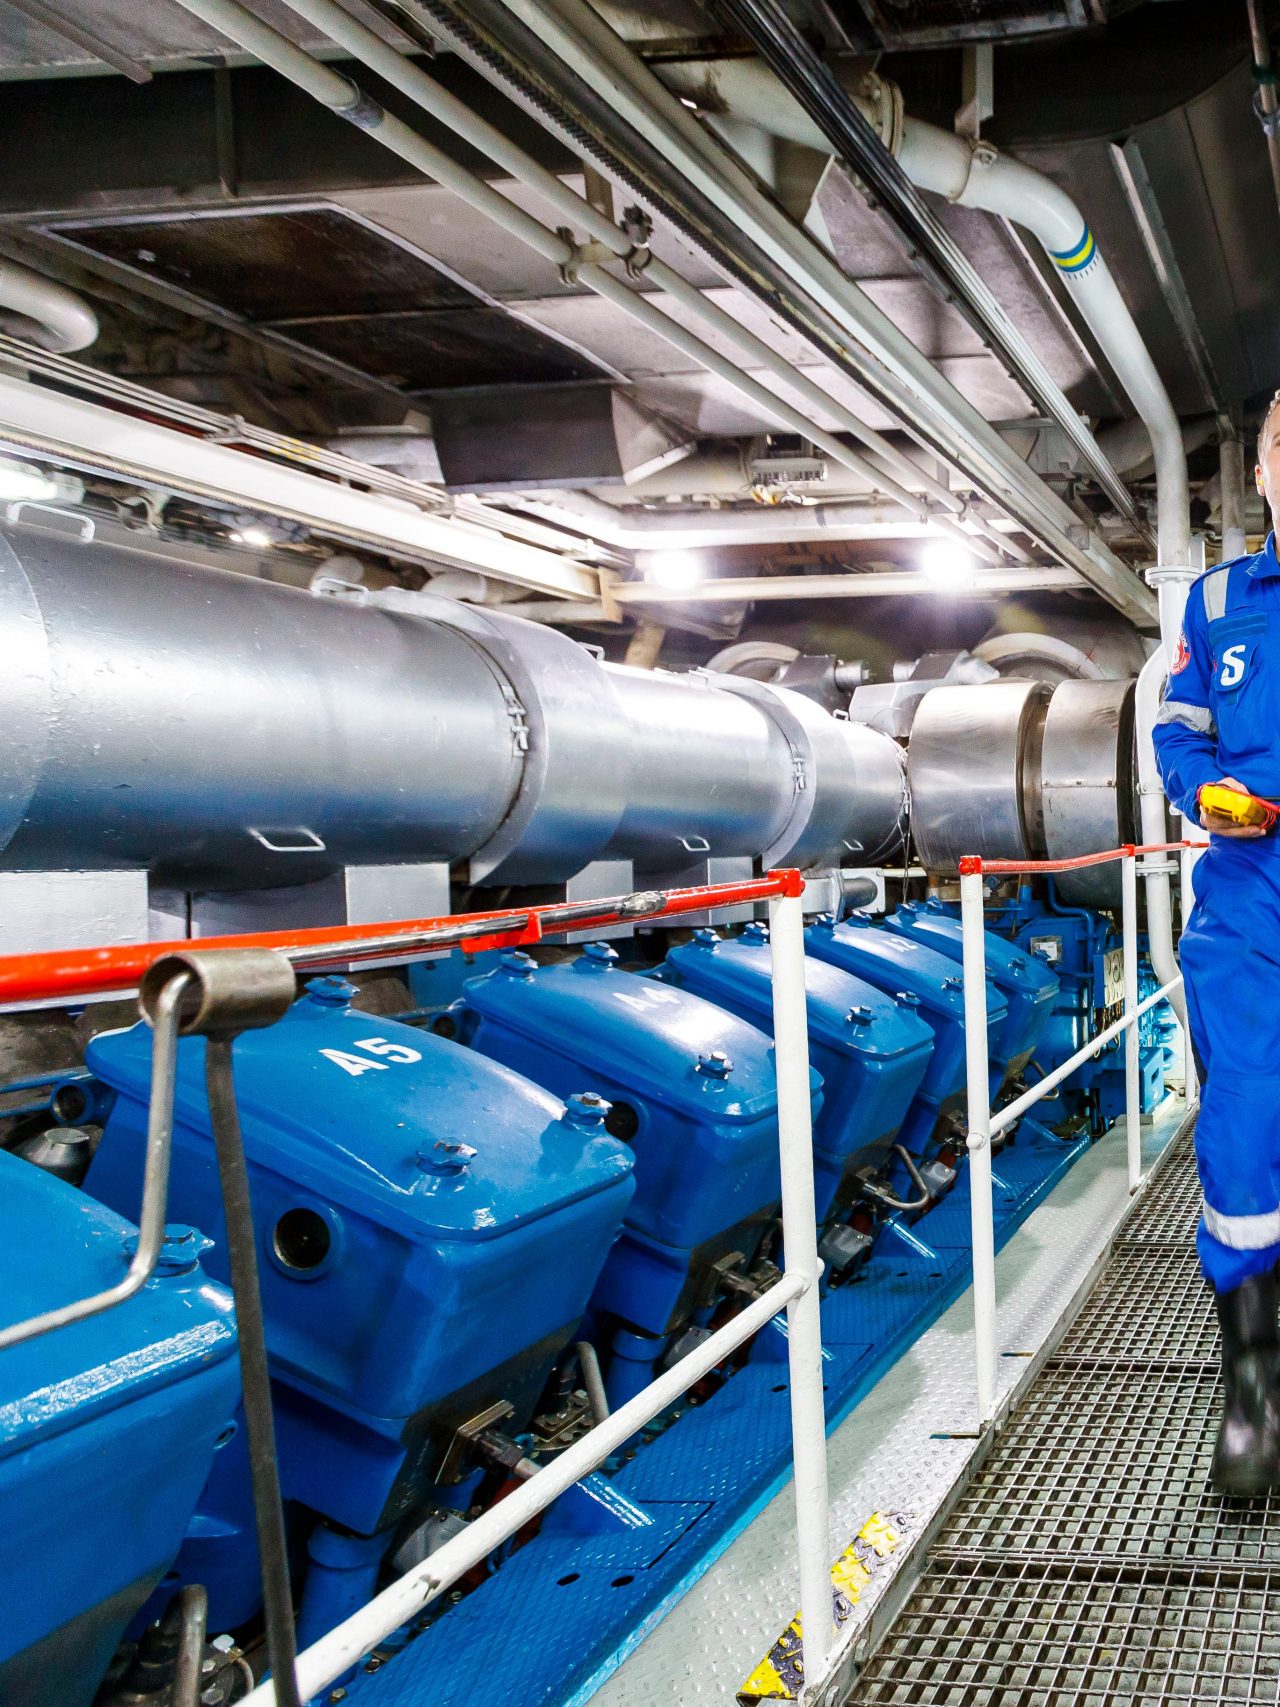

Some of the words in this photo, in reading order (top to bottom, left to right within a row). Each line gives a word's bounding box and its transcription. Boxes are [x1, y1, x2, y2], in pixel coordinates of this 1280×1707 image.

[1220, 644, 1246, 687] S
[880, 937, 918, 952] A2
[611, 986, 680, 1012] A4
[318, 1037, 423, 1077] A5
